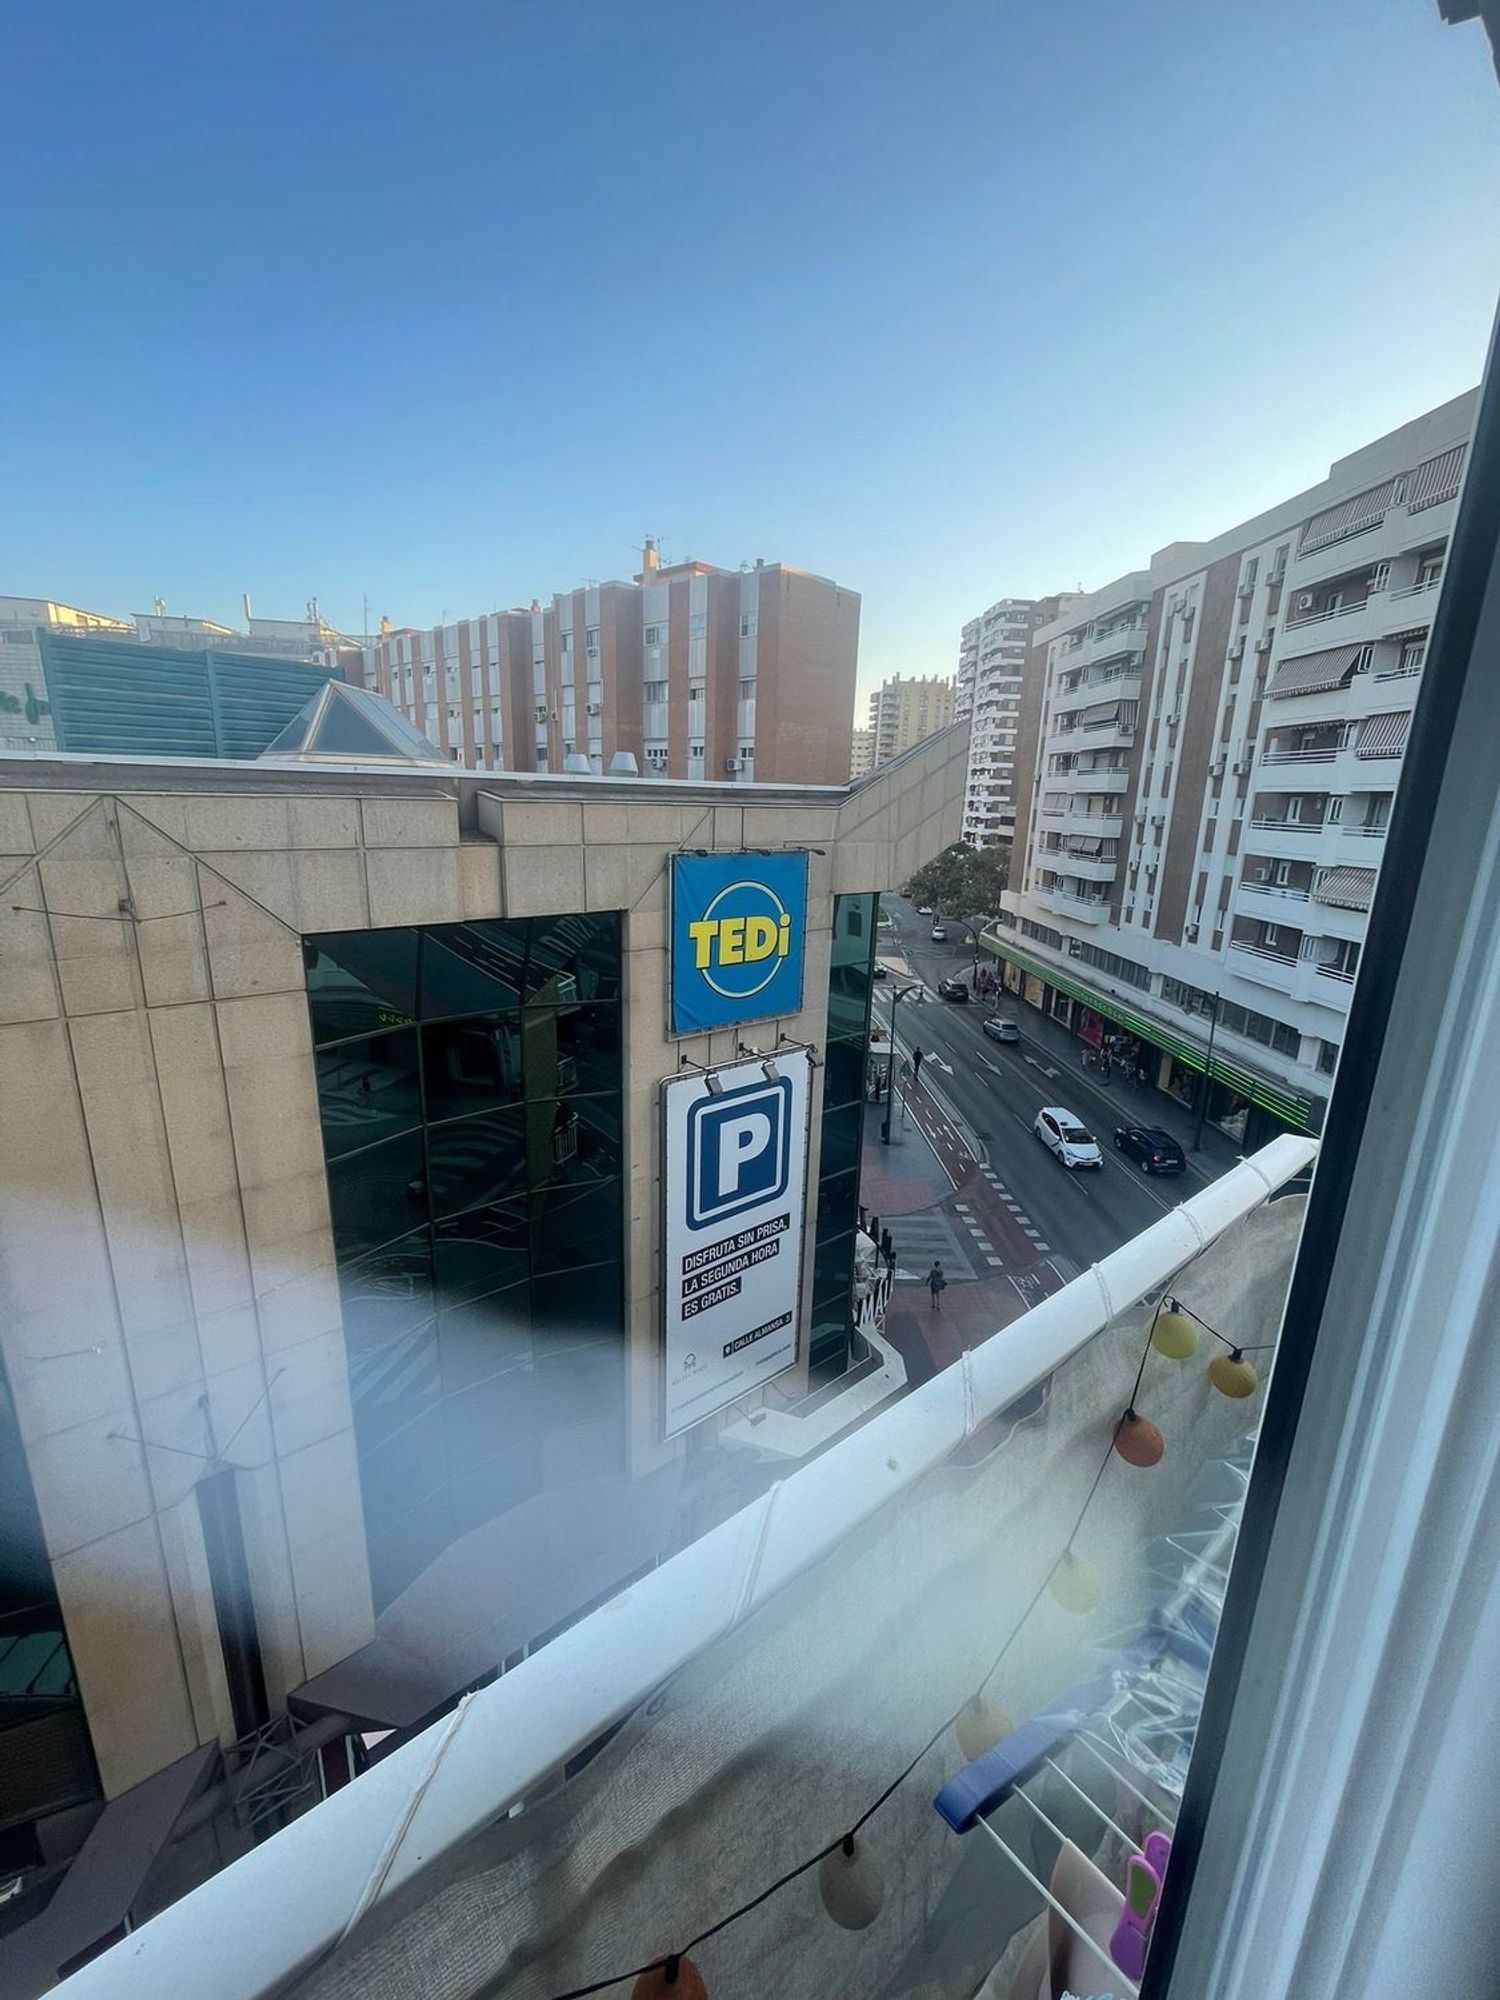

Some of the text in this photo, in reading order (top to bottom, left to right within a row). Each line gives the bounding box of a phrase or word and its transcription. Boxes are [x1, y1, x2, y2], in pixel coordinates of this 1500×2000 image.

[689, 913, 791, 969] TEDi
[718, 1113, 771, 1197] P
[684, 1239, 736, 1271] DISFRUTA
[737, 1233, 755, 1248] SIN
[684, 1242, 778, 1295] LA SEGUNDA HORA
[684, 1301, 699, 1317] ES
[734, 1334, 754, 1350] CALLE
